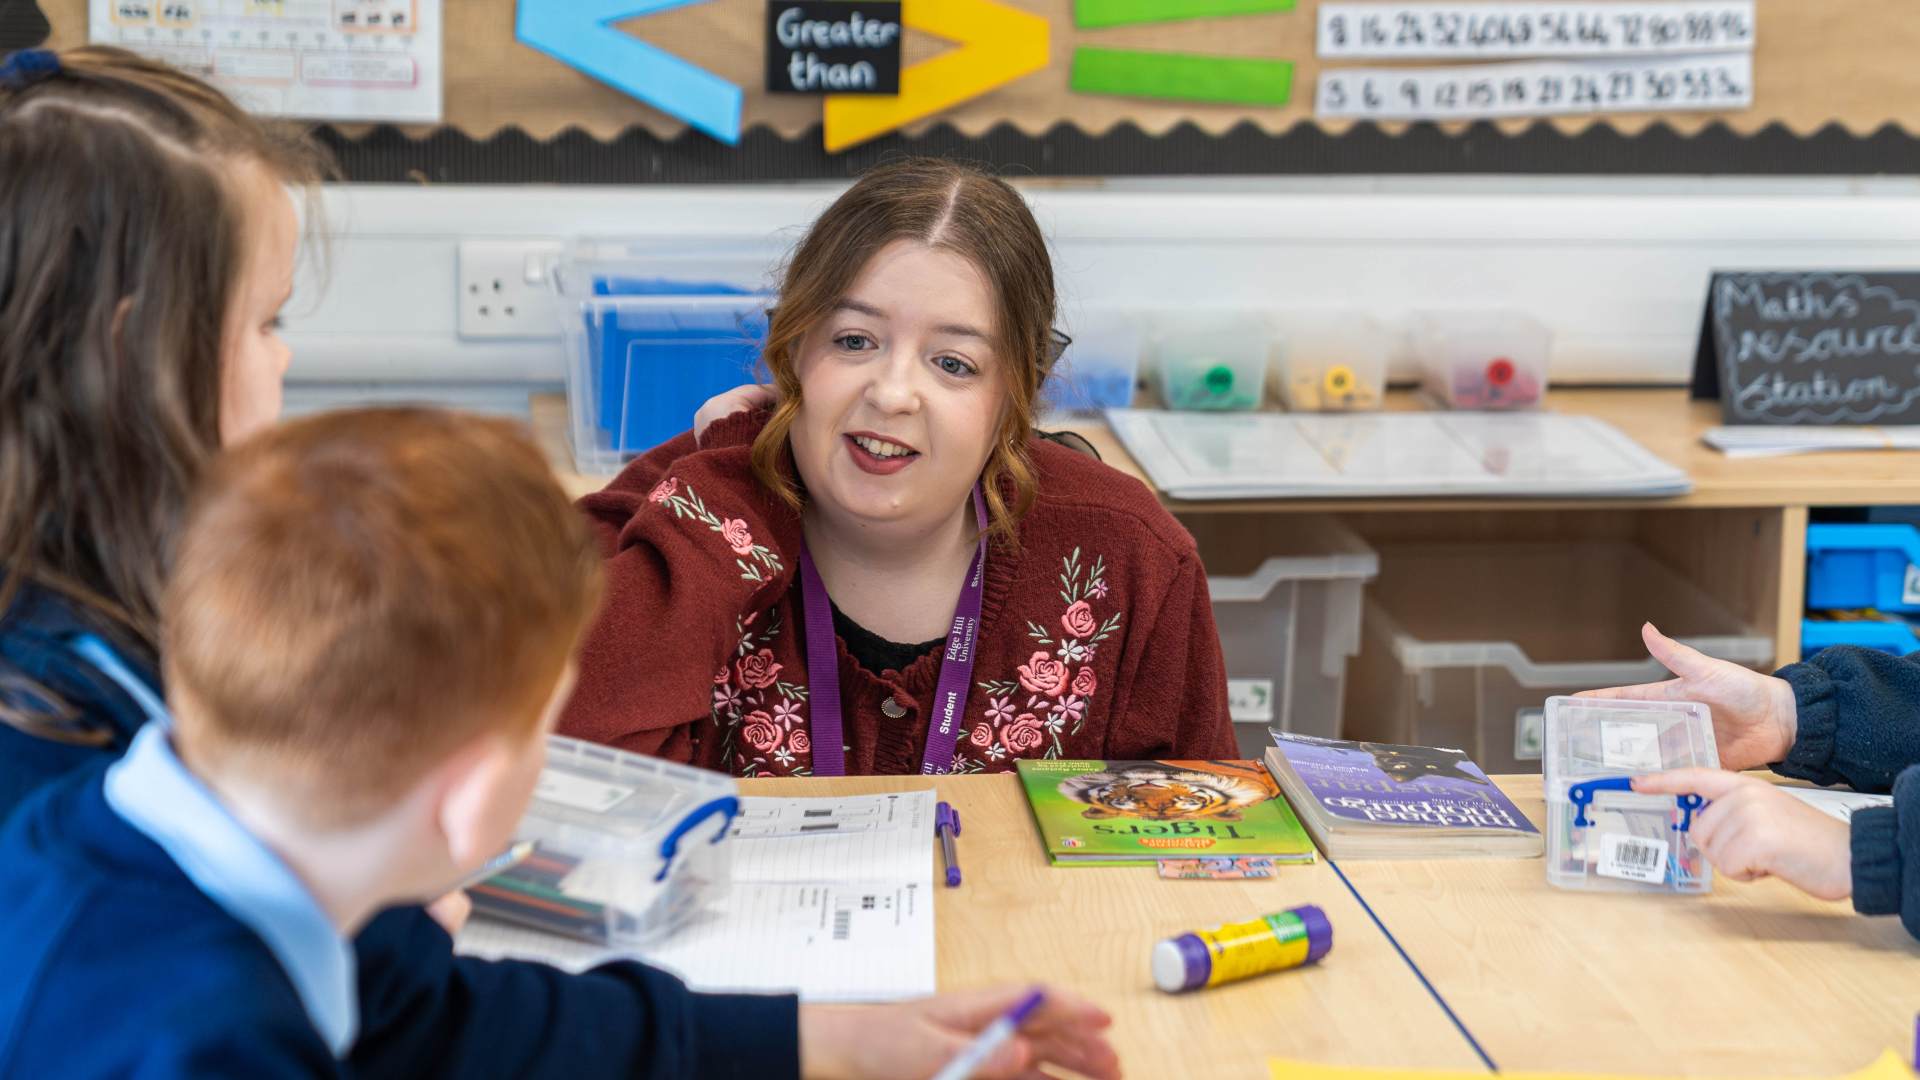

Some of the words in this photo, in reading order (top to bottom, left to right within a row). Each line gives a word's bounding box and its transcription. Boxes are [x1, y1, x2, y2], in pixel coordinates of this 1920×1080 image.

[776, 7, 899, 48] Greater
[1361, 14, 1387, 44] 16
[1396, 12, 1424, 44] 24
[1433, 13, 1461, 44] 32
[1467, 15, 1499, 45] 40
[1500, 14, 1531, 45] 48
[1540, 13, 1569, 41] 56
[1615, 14, 1642, 44] 72
[1650, 15, 1680, 43] 80
[788, 51, 877, 90] than
[1363, 79, 1382, 108] 6
[1401, 79, 1419, 108] 9
[1435, 81, 1457, 108] 12
[1467, 80, 1495, 107] 15
[1537, 77, 1562, 103] 21
[1571, 75, 1599, 103] 24
[1608, 72, 1634, 99] 27
[1644, 70, 1675, 98] 30
[1715, 279, 1858, 321] Maths
[1737, 372, 1898, 414] Station
[953, 616, 964, 634] Hill
[959, 617, 976, 662] University
[947, 637, 961, 661] Edge
[940, 692, 957, 734] Student
[1093, 822, 1255, 839] Tigers
